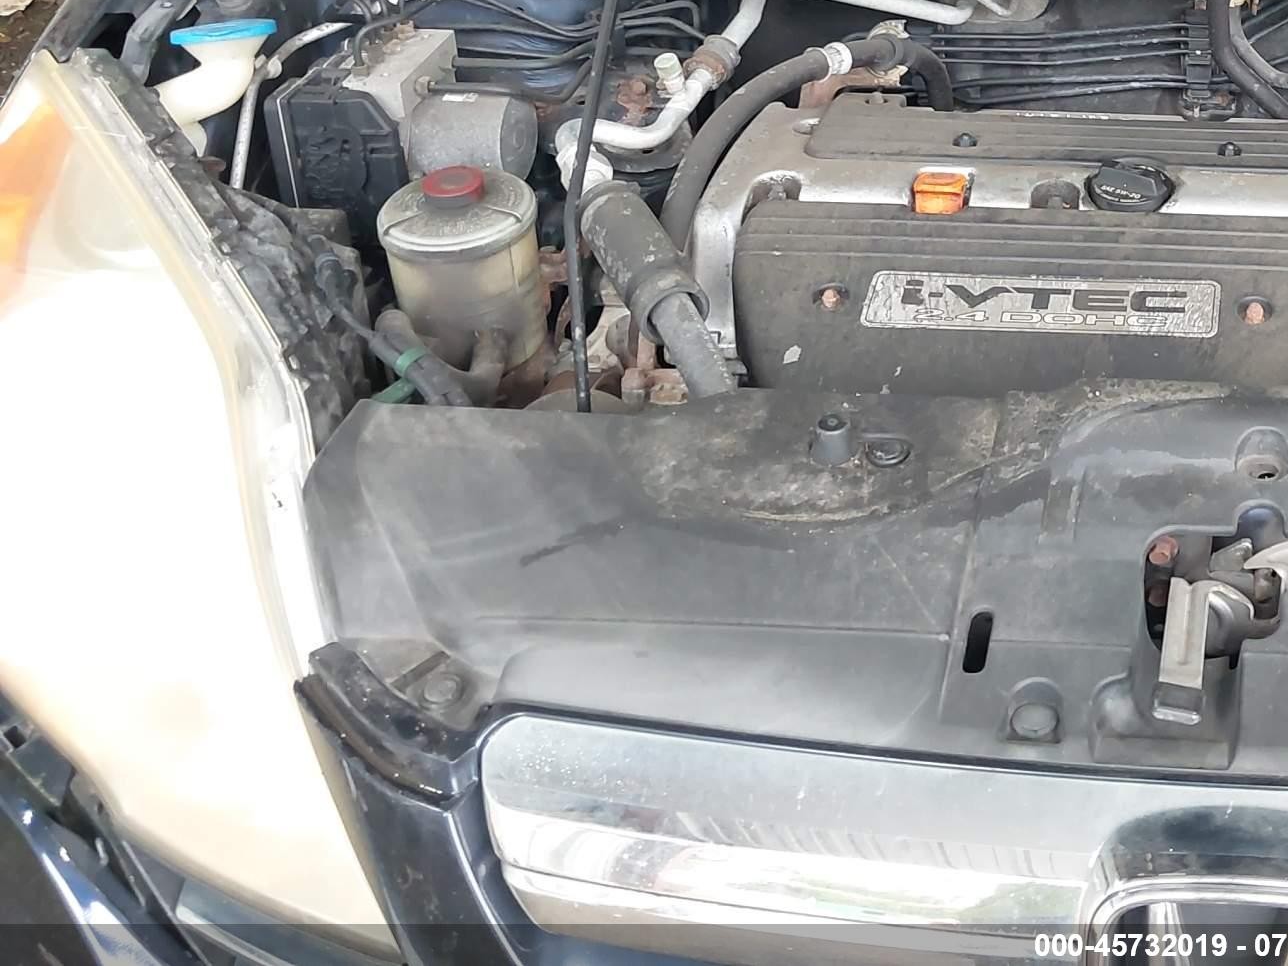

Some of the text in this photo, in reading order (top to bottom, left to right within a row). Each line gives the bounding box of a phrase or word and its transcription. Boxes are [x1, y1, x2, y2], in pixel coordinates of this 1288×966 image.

[901, 279, 1187, 313] i-VTEC
[914, 308, 1168, 328] 2.4 DOHC
